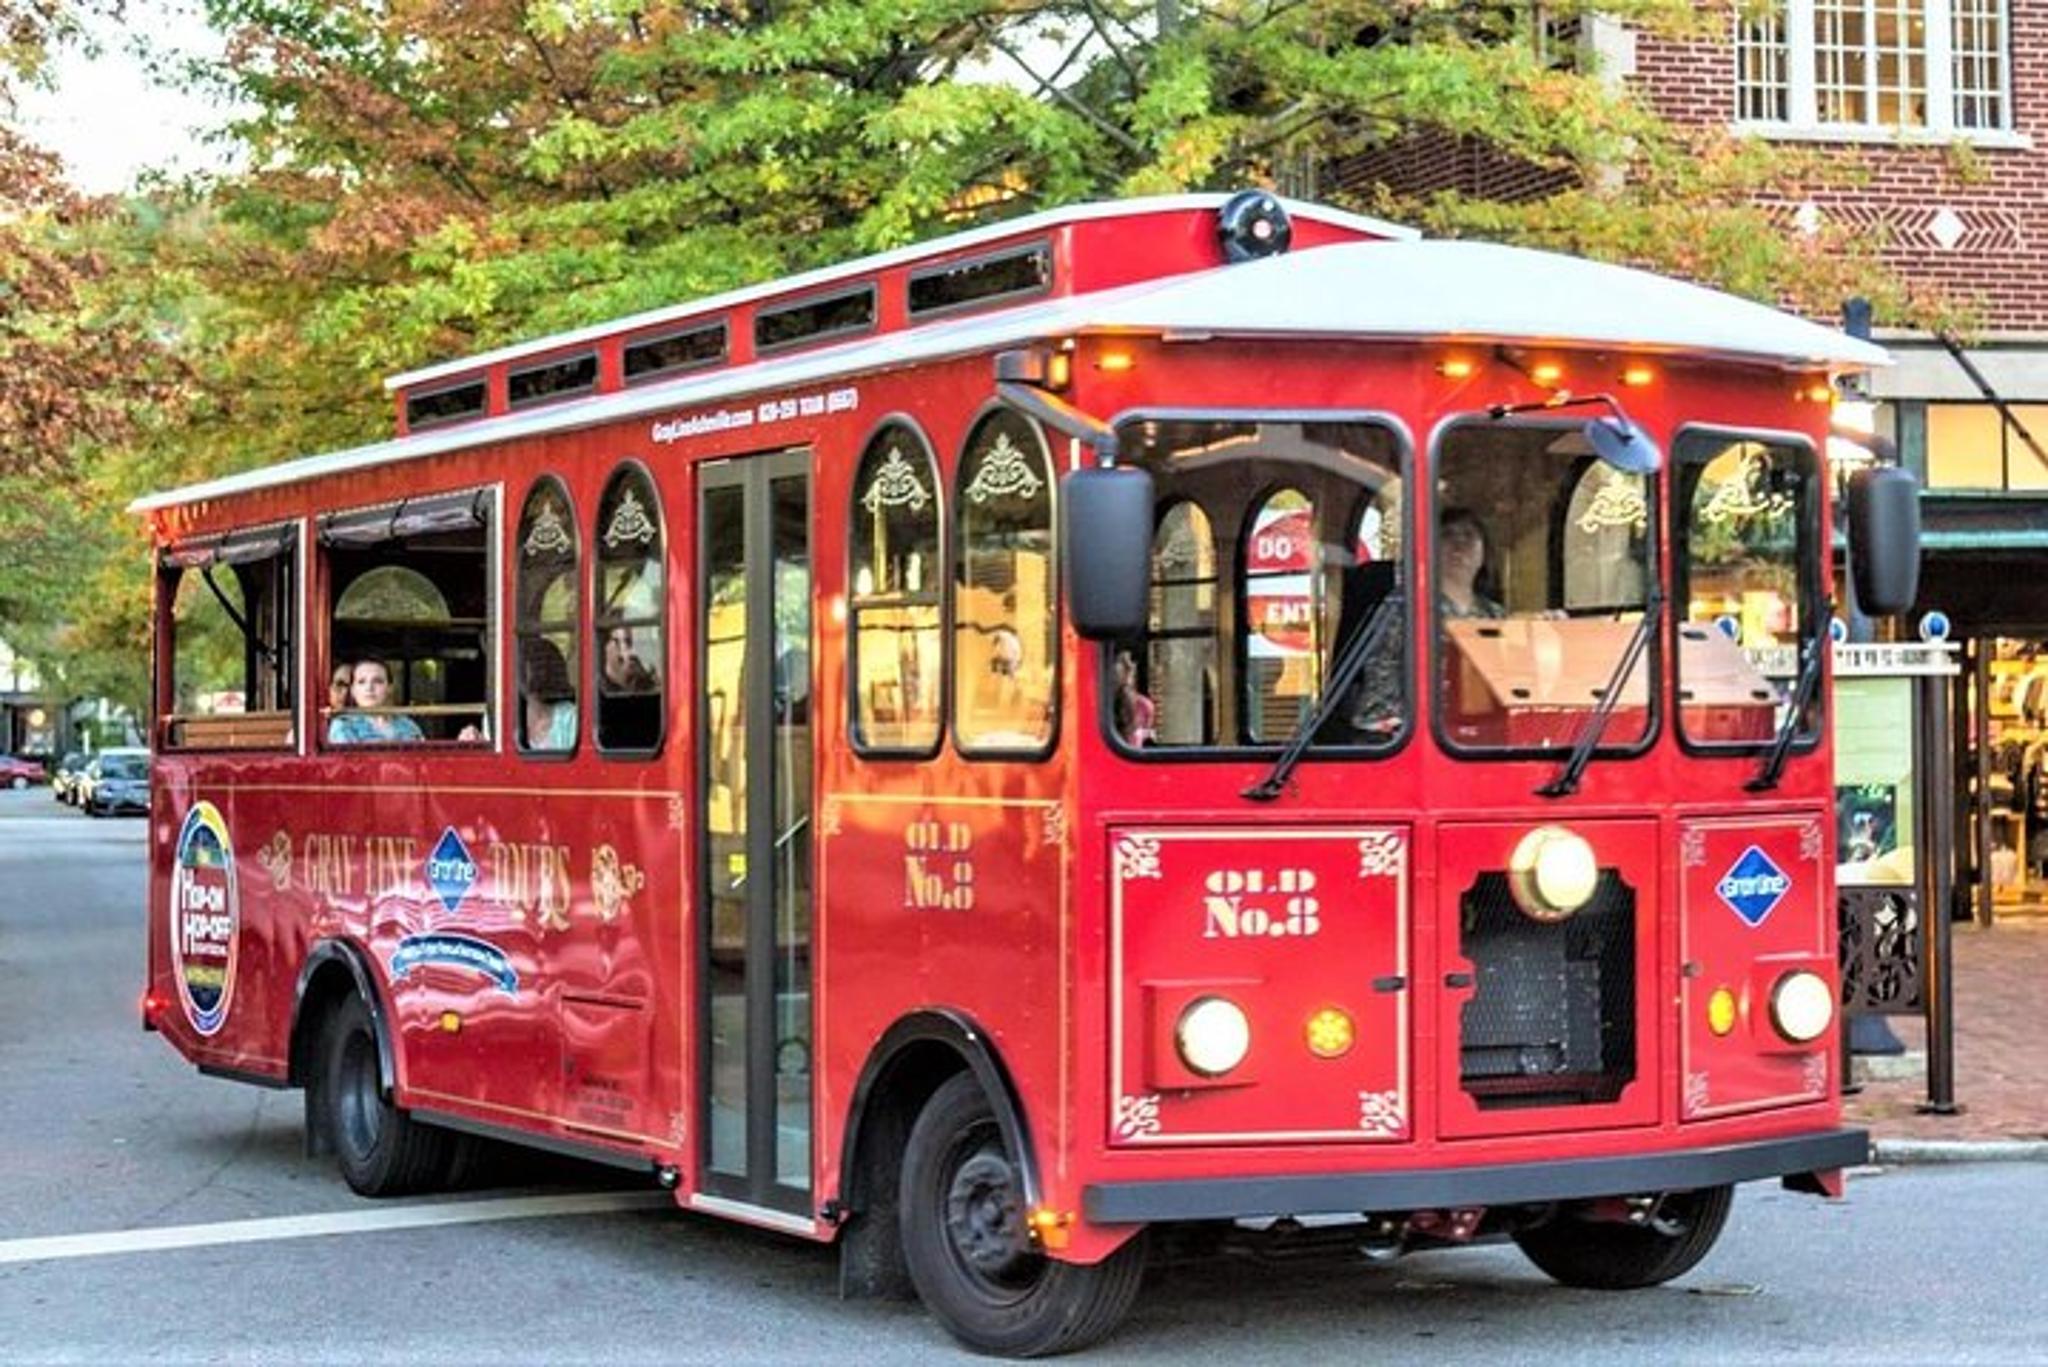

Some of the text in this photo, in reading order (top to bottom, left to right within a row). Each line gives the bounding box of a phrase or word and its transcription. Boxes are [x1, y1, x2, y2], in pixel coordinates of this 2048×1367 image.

[1258, 536, 1291, 560] DO
[905, 821, 972, 852] OLD
[304, 833, 416, 897] GRAY LINE
[488, 841, 571, 928] TOURS
[1204, 868, 1317, 894] OLD
